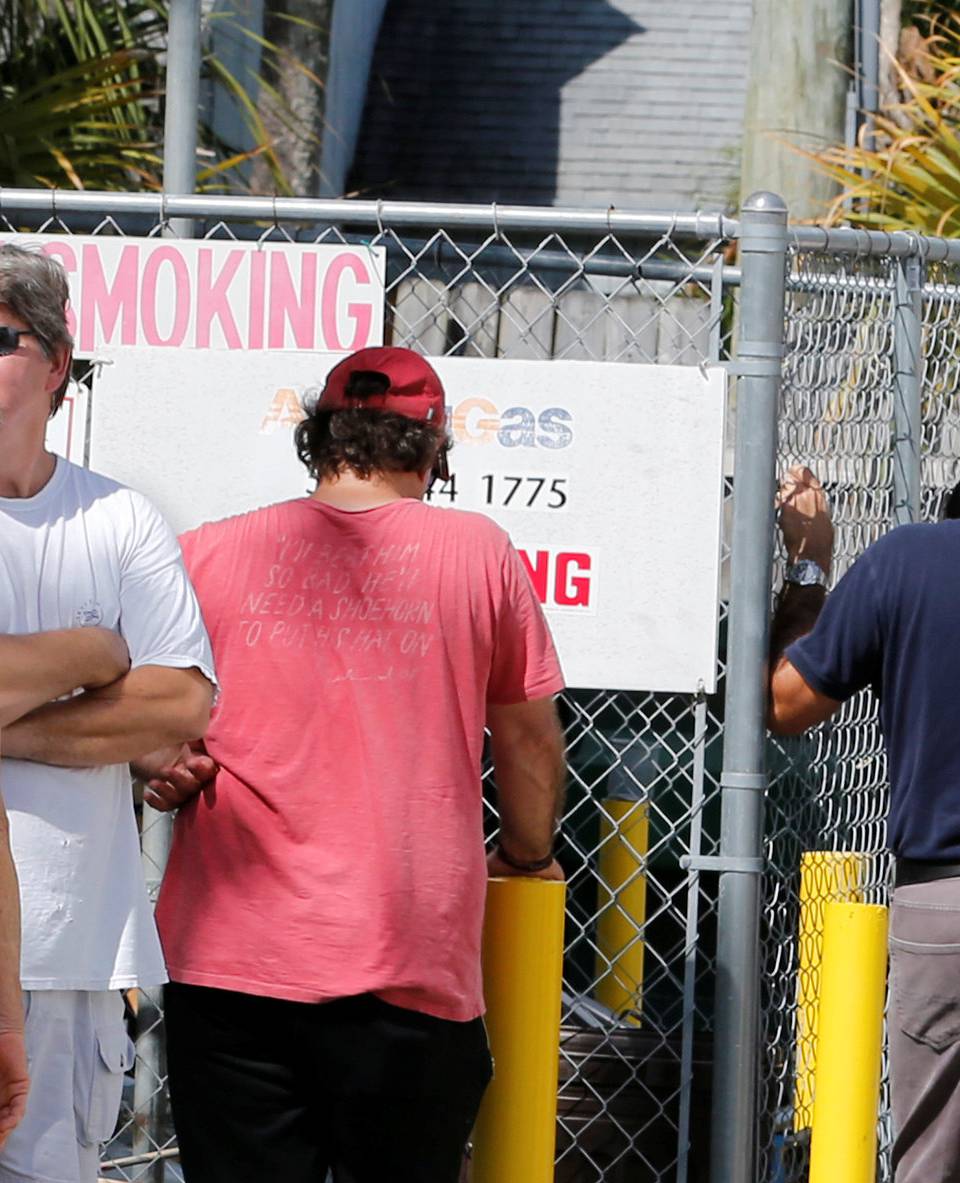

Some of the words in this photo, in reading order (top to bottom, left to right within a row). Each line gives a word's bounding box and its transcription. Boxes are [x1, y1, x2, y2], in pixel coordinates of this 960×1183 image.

[482, 474, 567, 509] 1775
[264, 564, 294, 588] SO
[518, 549, 591, 607] NG
[240, 592, 304, 616] NEED
[308, 599, 324, 620] A
[239, 620, 262, 647] TO
[269, 620, 312, 648] PUT
[400, 629, 435, 657] ON
